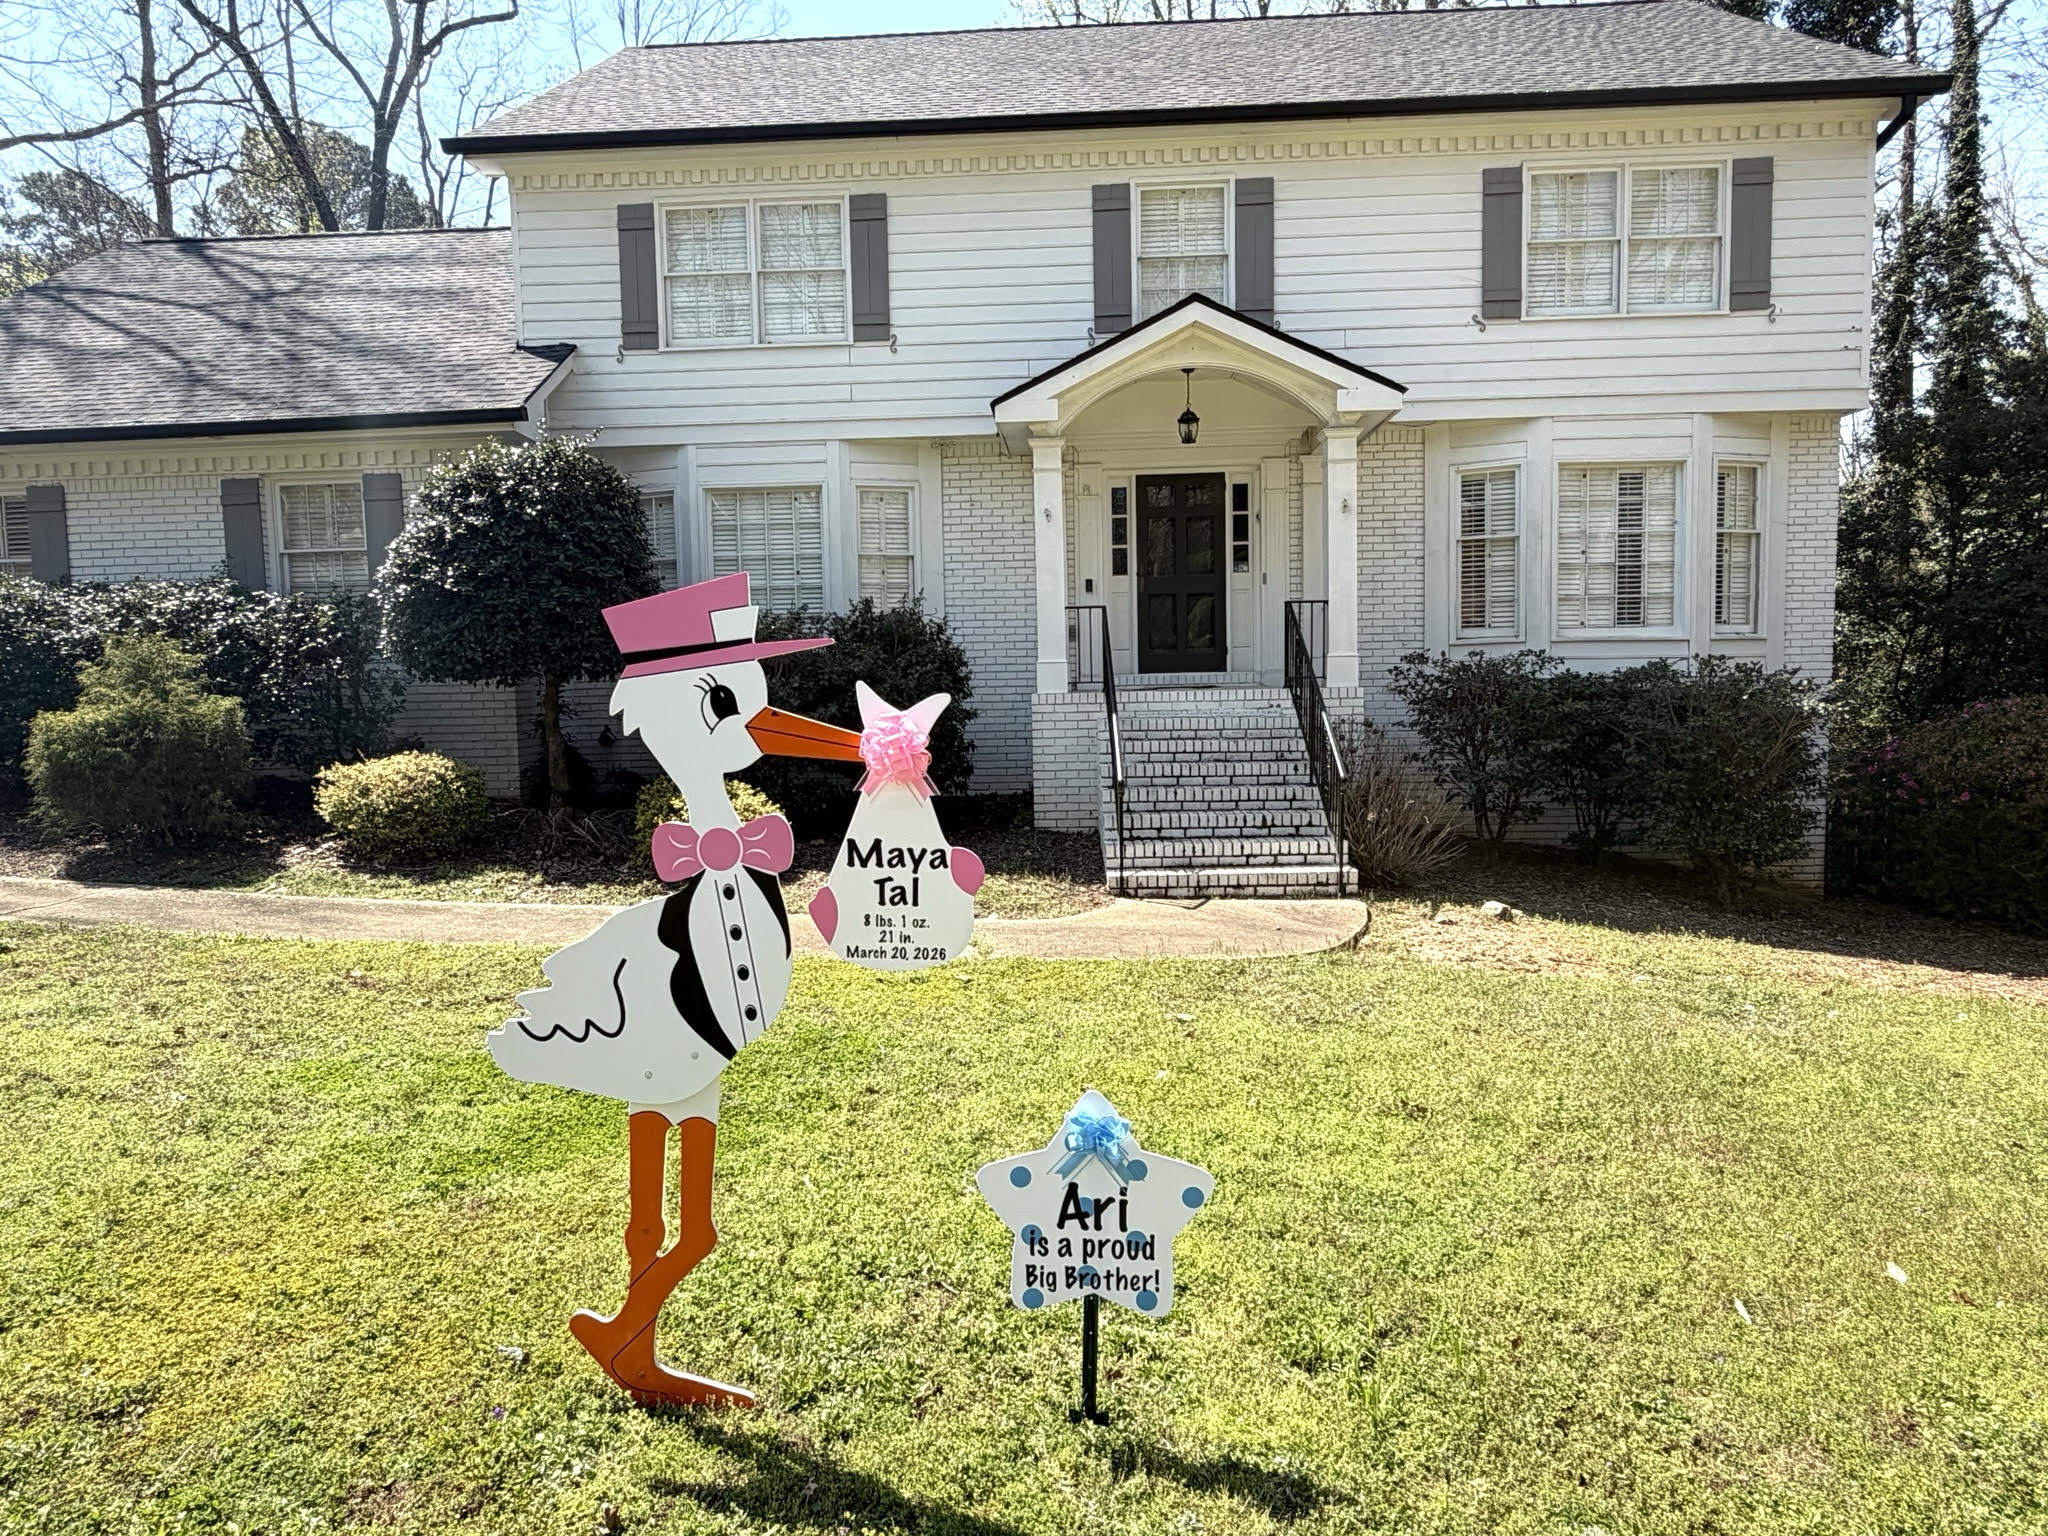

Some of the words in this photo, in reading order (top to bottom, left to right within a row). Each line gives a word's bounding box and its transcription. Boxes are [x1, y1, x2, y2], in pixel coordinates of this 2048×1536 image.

[847, 838, 949, 874] Maya
[873, 876, 919, 907] Tal
[864, 913, 871, 927] 8
[876, 914, 896, 928] lbs.
[902, 914, 906, 928] 1
[913, 919, 930, 929] oz.
[879, 930, 893, 943] 21
[900, 931, 915, 944] in.
[847, 946, 887, 959] March
[891, 947, 909, 961] 20,
[914, 948, 946, 960] 2026
[1056, 1182, 1128, 1232] Ari
[1030, 1230, 1049, 1257] is
[1058, 1238, 1073, 1258] a
[1083, 1234, 1155, 1264] proud
[1026, 1264, 1056, 1292] Big
[1065, 1266, 1160, 1293] Brother!
